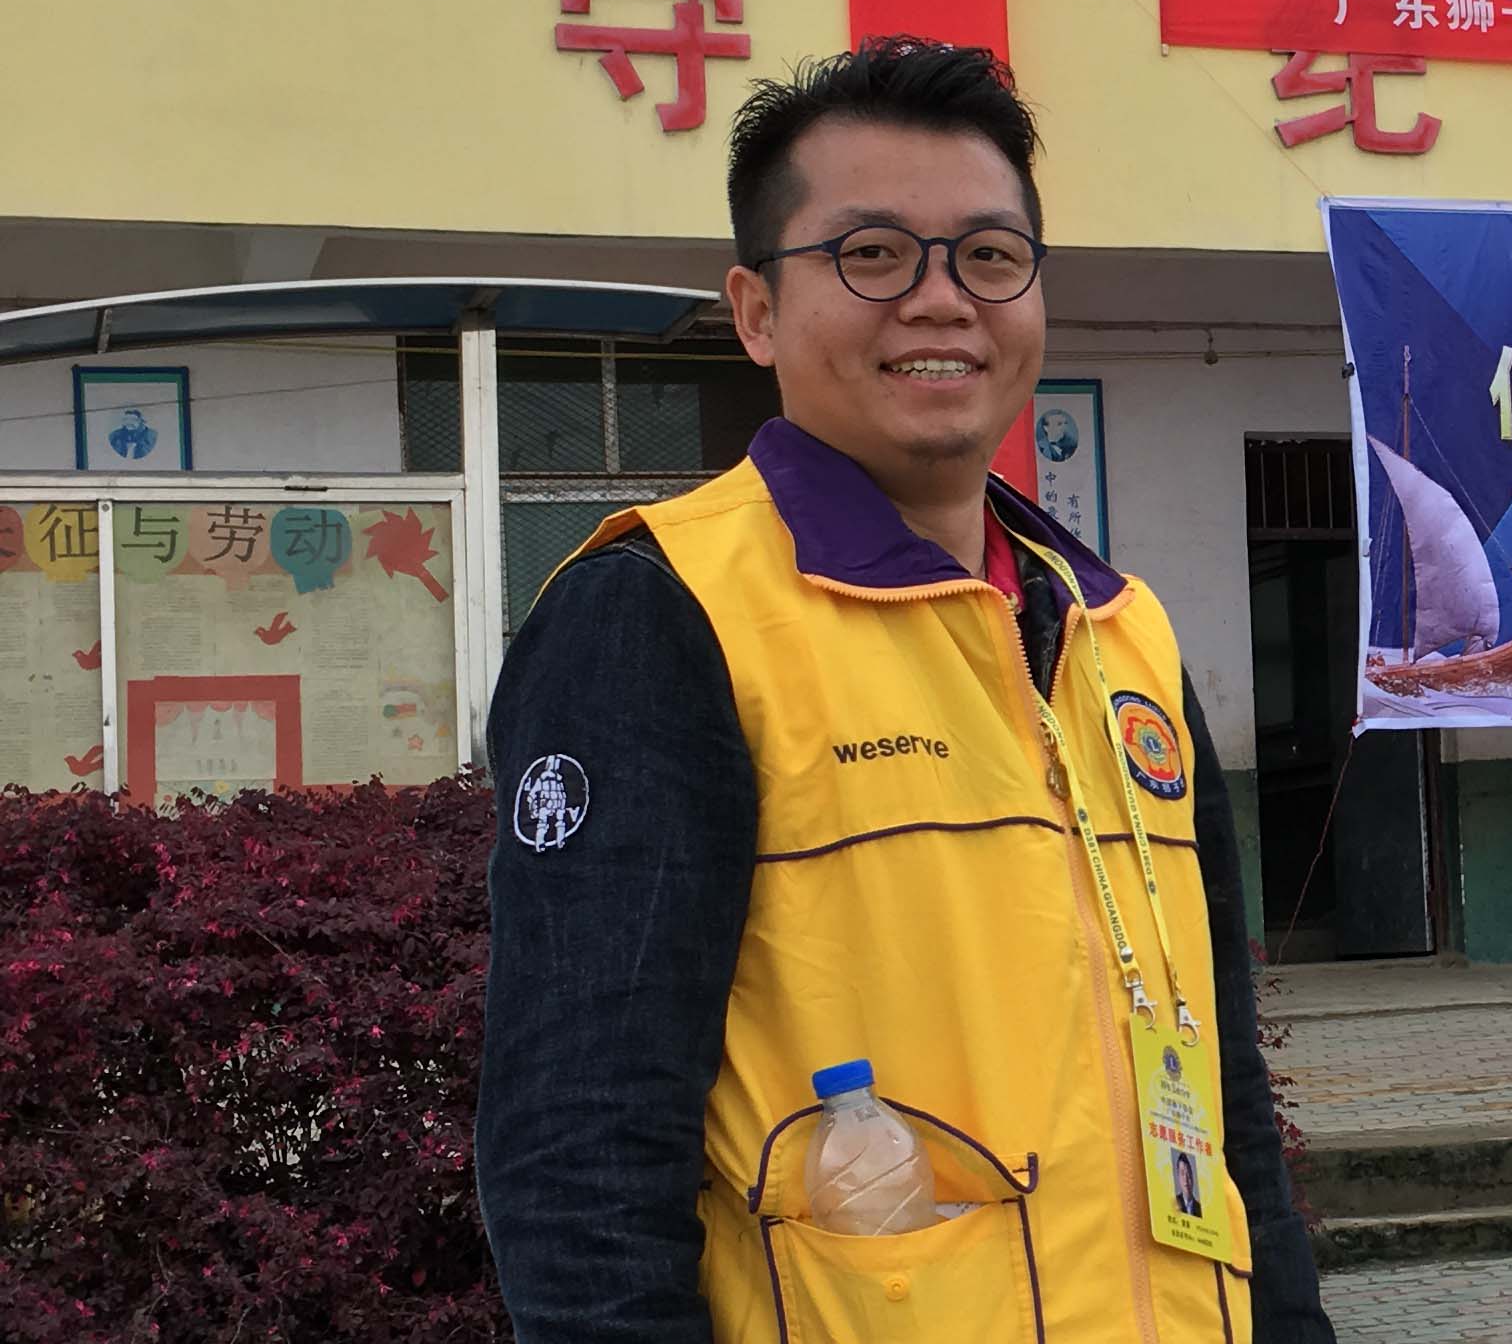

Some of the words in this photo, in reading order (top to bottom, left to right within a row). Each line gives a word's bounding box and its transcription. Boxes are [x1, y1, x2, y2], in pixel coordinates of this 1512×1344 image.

[0, 503, 344, 564] 征与劳动
[832, 735, 950, 764] weserve
[1091, 855, 1109, 891] CHINA
